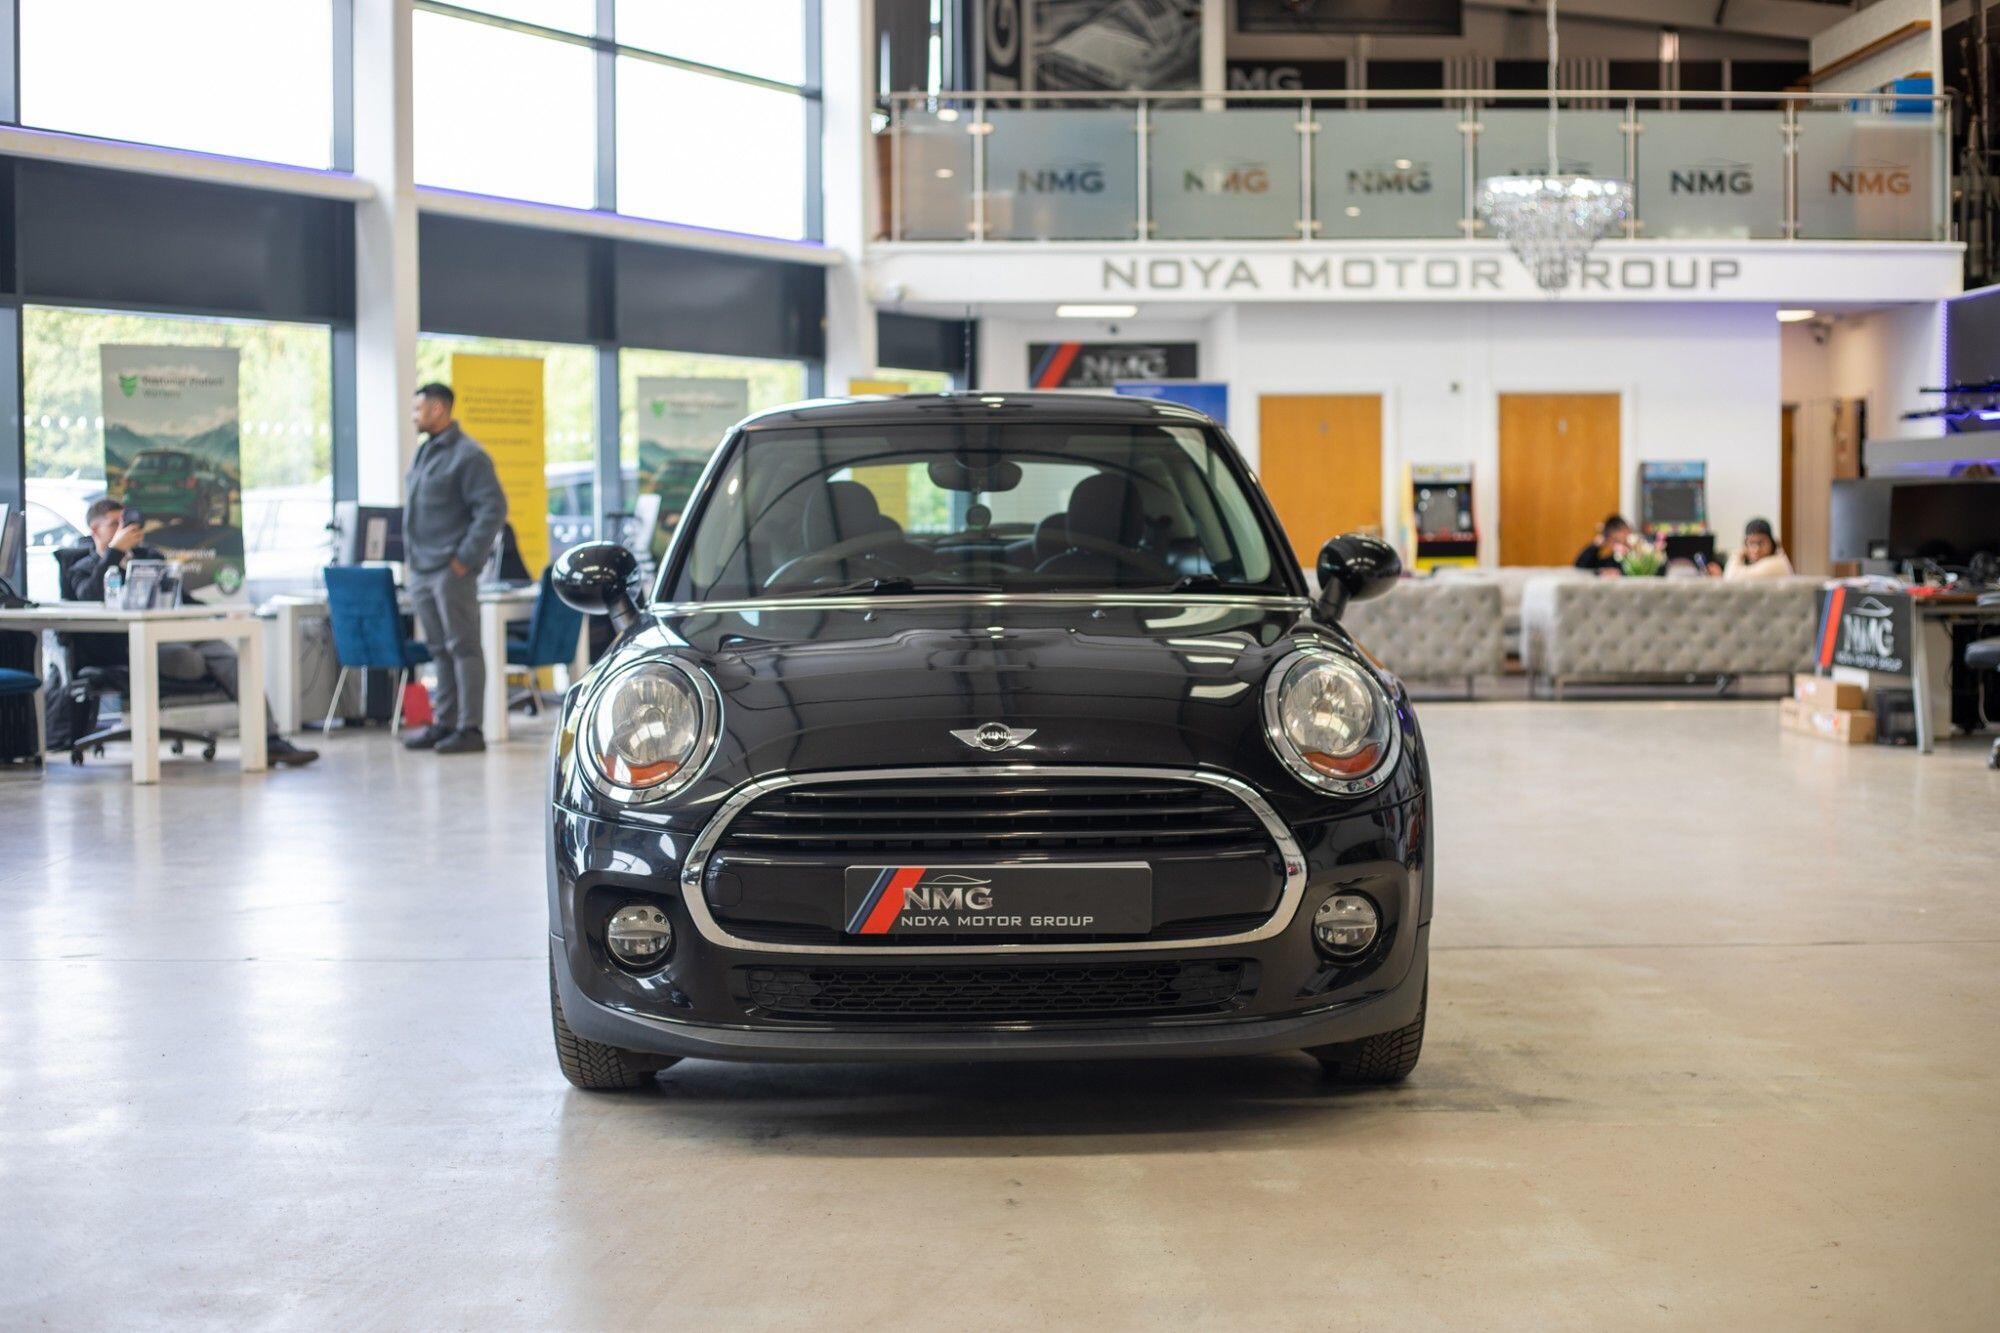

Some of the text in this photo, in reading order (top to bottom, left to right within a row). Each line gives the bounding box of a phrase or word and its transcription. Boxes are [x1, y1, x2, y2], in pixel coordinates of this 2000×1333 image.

[1018, 169, 1105, 194] NMG
[1345, 169, 1433, 194] NMG
[1671, 169, 1753, 195] NMG
[1829, 169, 1911, 195] NMG
[1101, 258, 1741, 290] NOYA MOTOR GROUP
[1843, 613, 1895, 657] NMG
[980, 731, 1011, 740] MINI
[902, 887, 994, 910] NMG
[901, 915, 1095, 927] NOYA MOTOR GROUP
